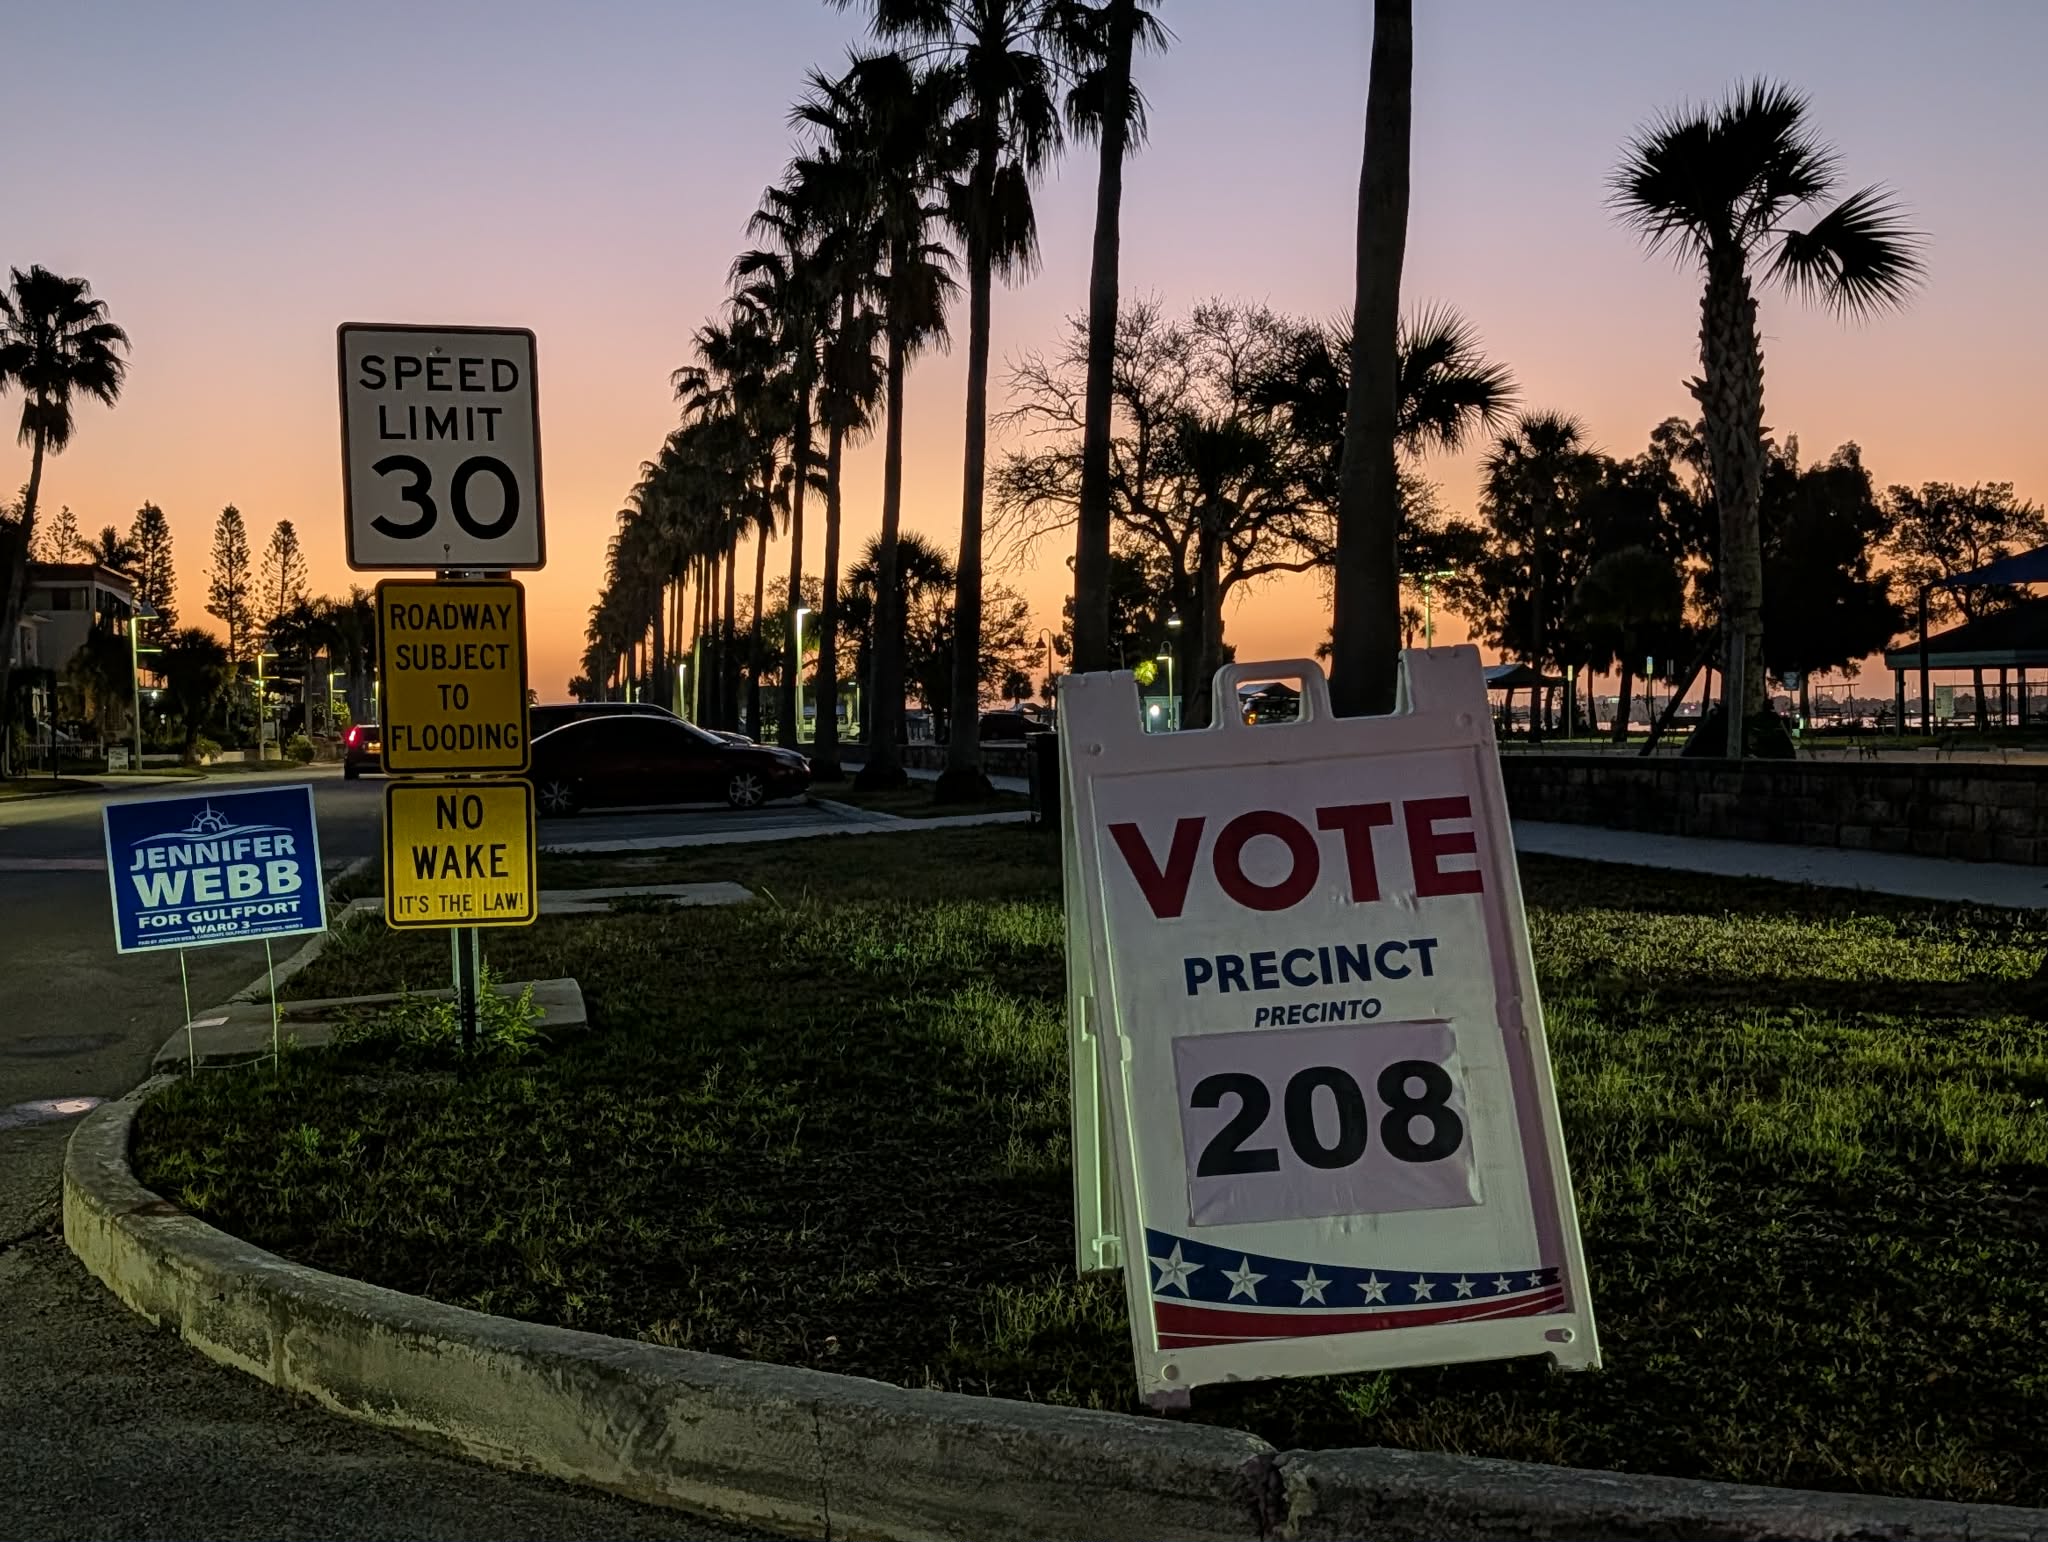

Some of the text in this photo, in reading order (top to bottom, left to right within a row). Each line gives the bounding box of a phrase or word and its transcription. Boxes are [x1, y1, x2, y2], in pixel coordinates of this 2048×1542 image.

[359, 354, 520, 393] SPEED
[379, 404, 503, 441] LIMIT
[370, 454, 520, 540] 30
[390, 603, 512, 630] ROADWAY
[395, 643, 510, 671] SUBJECT
[437, 683, 469, 711] TO
[391, 722, 519, 752] FLOODING
[436, 794, 484, 830] NO
[130, 834, 297, 872] JENNIFER
[412, 843, 509, 880] WAKE
[1108, 795, 1485, 920] VOTE
[131, 859, 303, 908] WEBB
[138, 901, 301, 929] FOR GULFPORT
[399, 892, 524, 914] IT'S THE LAW!
[191, 920, 251, 935] WARD 3
[1183, 937, 1438, 996] PRECINCT
[1253, 998, 1382, 1028] PRECINTO
[1189, 1059, 1464, 1178] 208
